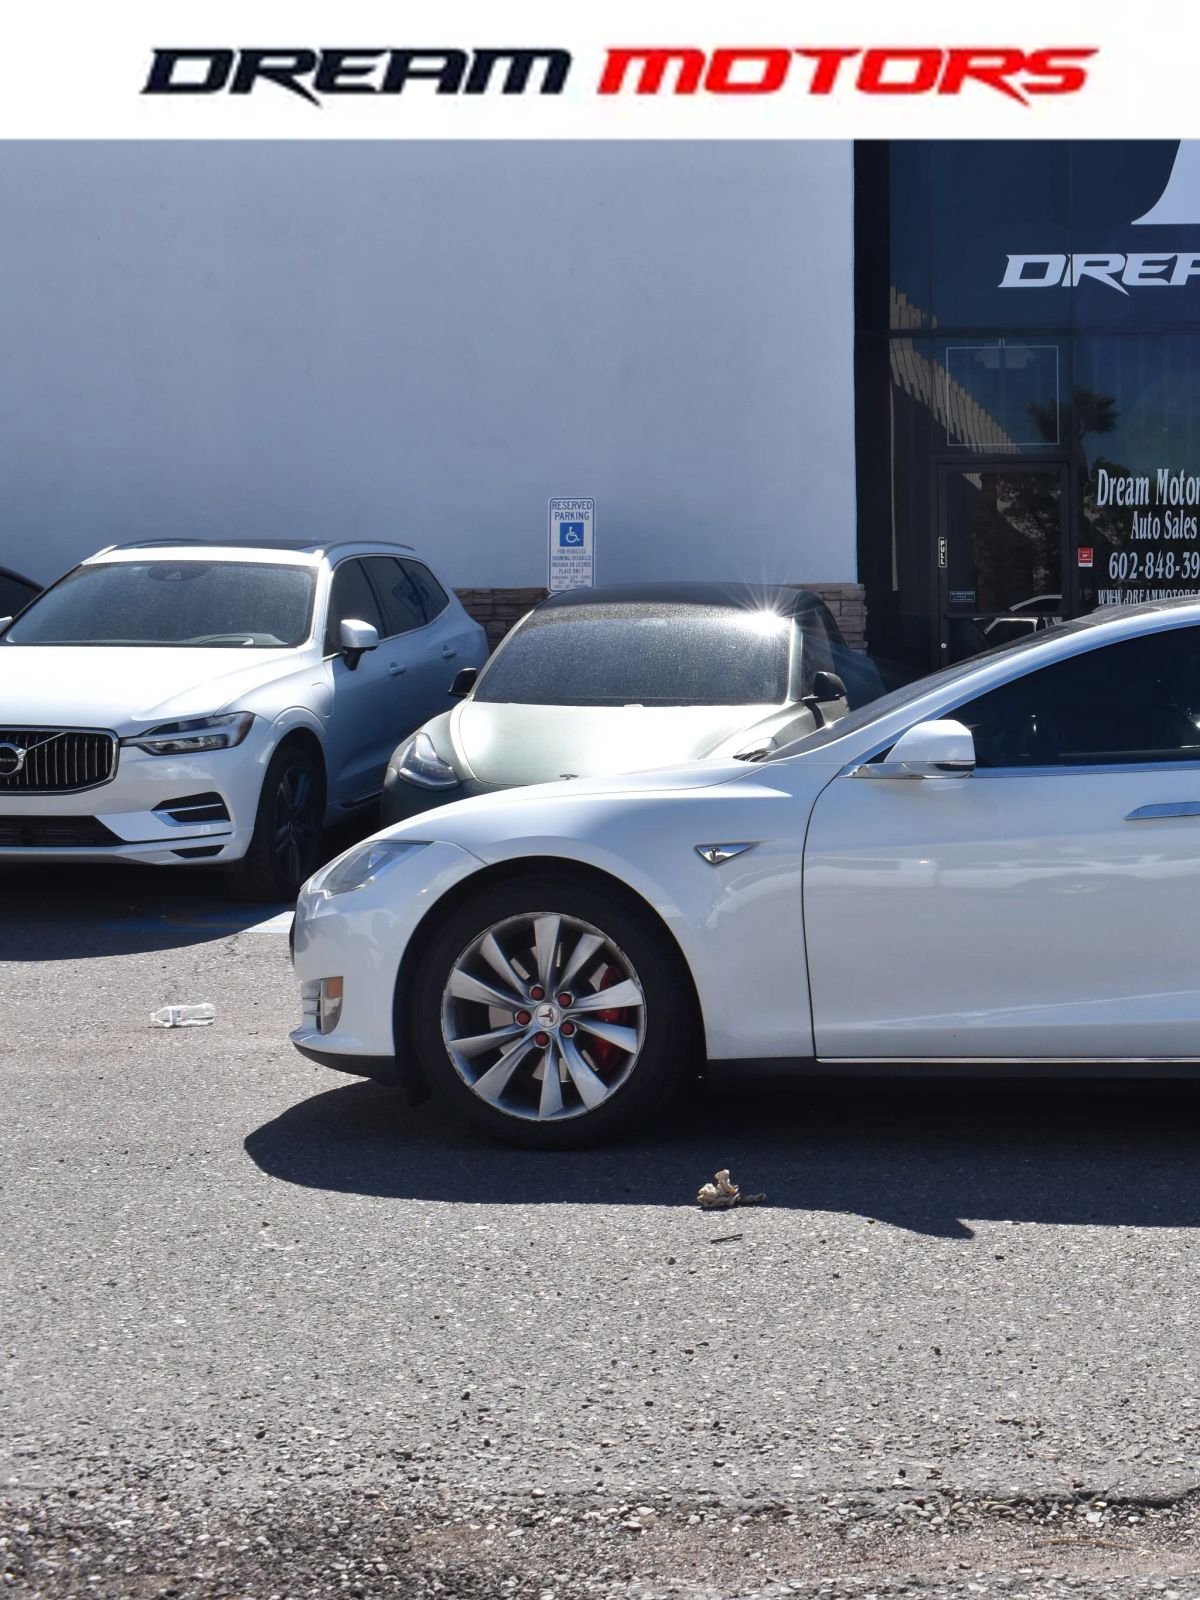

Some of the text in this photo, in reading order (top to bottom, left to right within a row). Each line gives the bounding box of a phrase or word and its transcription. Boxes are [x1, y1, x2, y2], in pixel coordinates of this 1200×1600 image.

[1097, 468, 1150, 506] Dream
[552, 501, 592, 510] RESERVED
[554, 511, 590, 520] PARKING
[1130, 509, 1198, 540] Auto Sales
